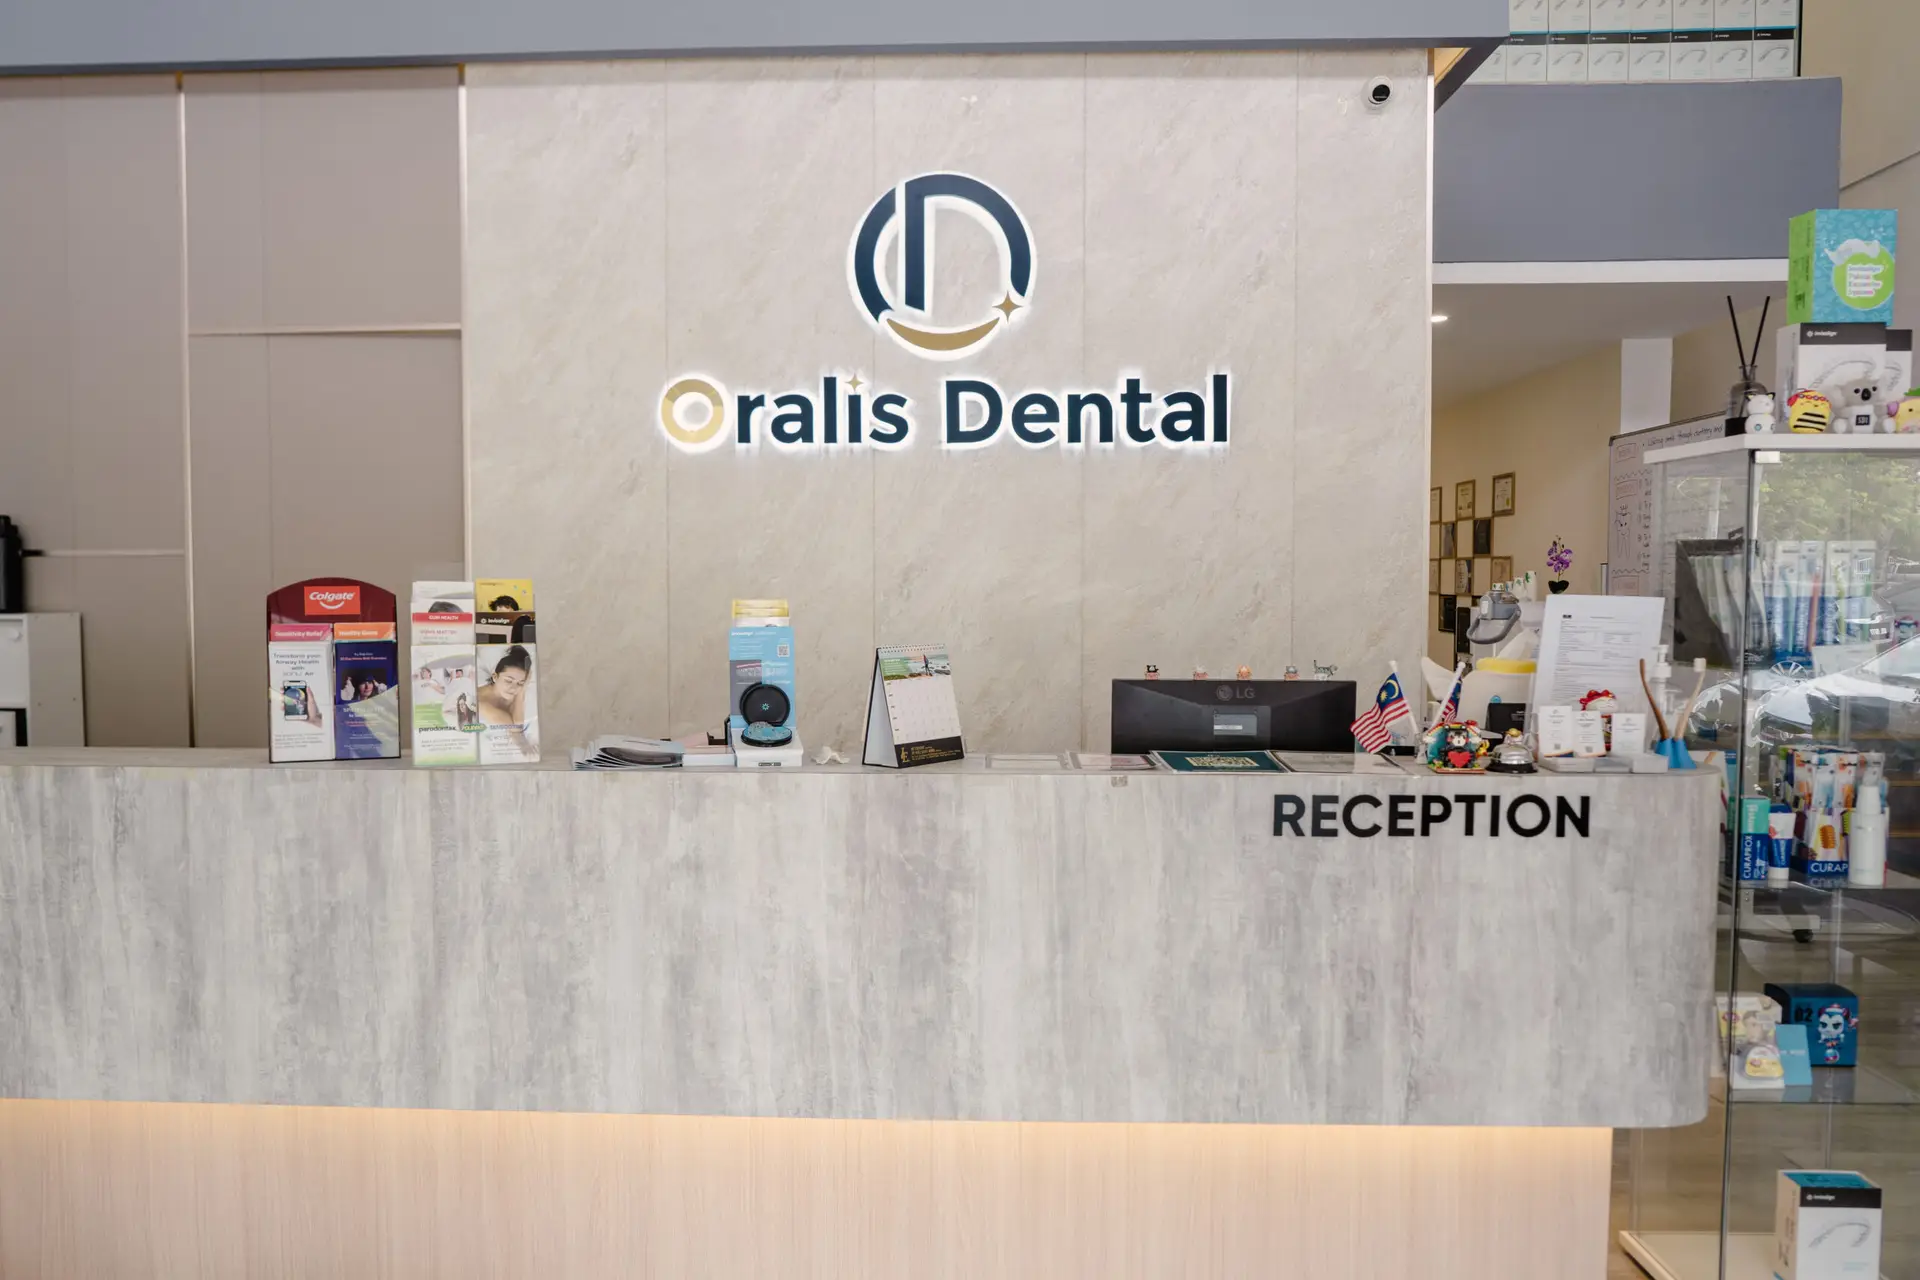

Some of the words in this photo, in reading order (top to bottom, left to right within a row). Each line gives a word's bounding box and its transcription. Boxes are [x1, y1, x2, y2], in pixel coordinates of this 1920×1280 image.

[661, 374, 909, 444] Oralis
[945, 373, 1228, 444] Dental
[309, 591, 355, 602] Colgate
[1236, 686, 1256, 699] LG
[418, 725, 457, 734] parodontax
[1273, 794, 1590, 838] RECEPTION
[1743, 835, 1753, 879] CURAPROX
